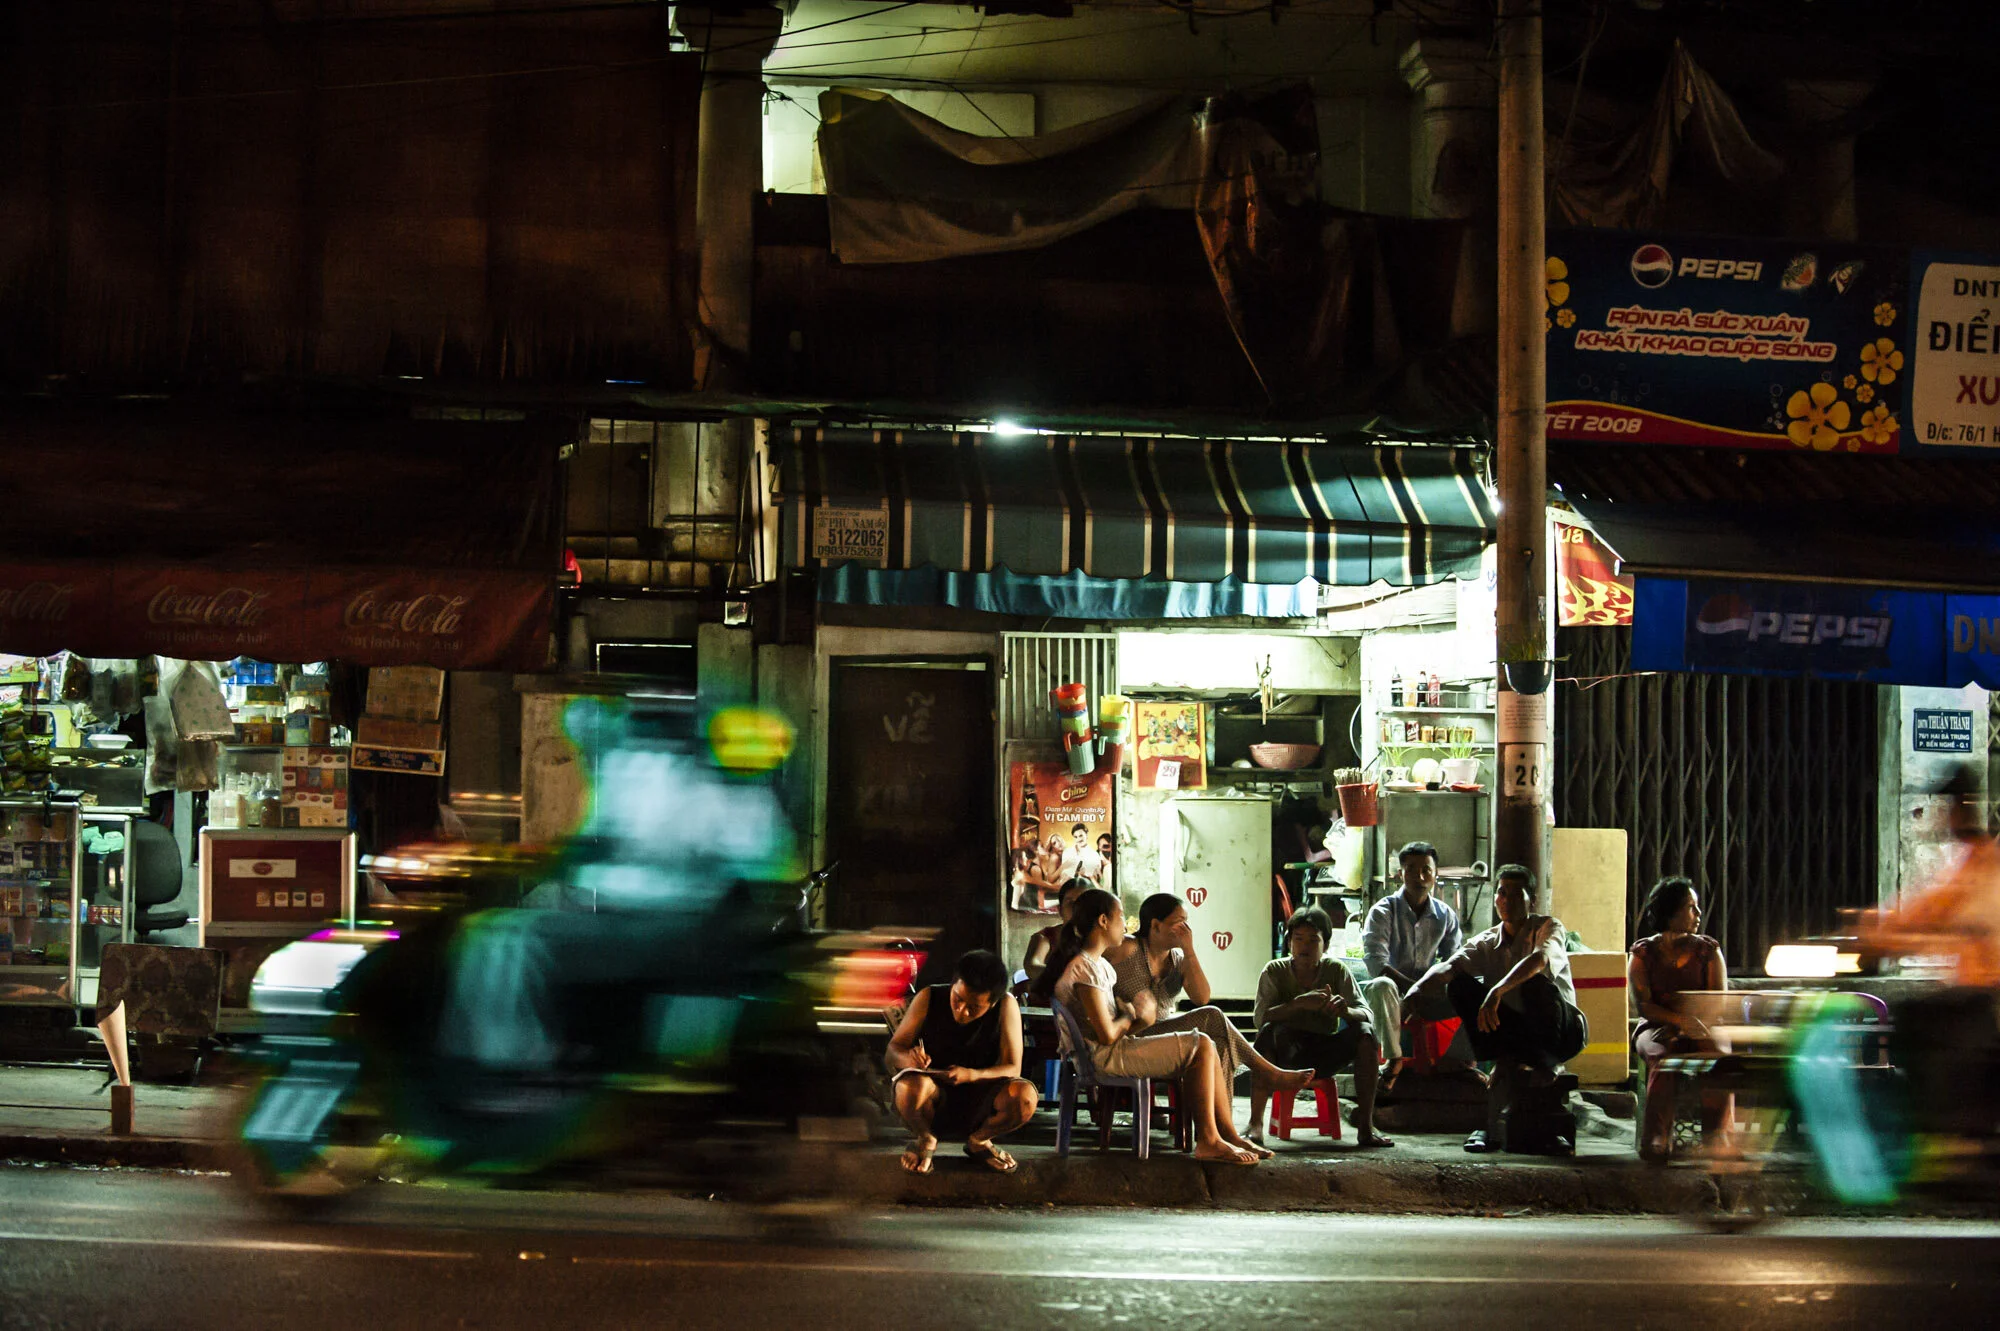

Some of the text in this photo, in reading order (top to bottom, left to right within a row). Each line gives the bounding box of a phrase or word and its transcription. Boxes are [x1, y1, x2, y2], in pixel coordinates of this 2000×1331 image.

[1678, 257, 1763, 281] PEPSI
[1642, 335, 1706, 353] KHAO
[1583, 415, 1642, 434] 2008
[1959, 424, 1985, 442] 76/1
[828, 528, 885, 547] 5122062
[1747, 611, 1893, 648] PEPSI
[1162, 766, 1177, 777] 29
[1056, 813, 1080, 822] CAM
